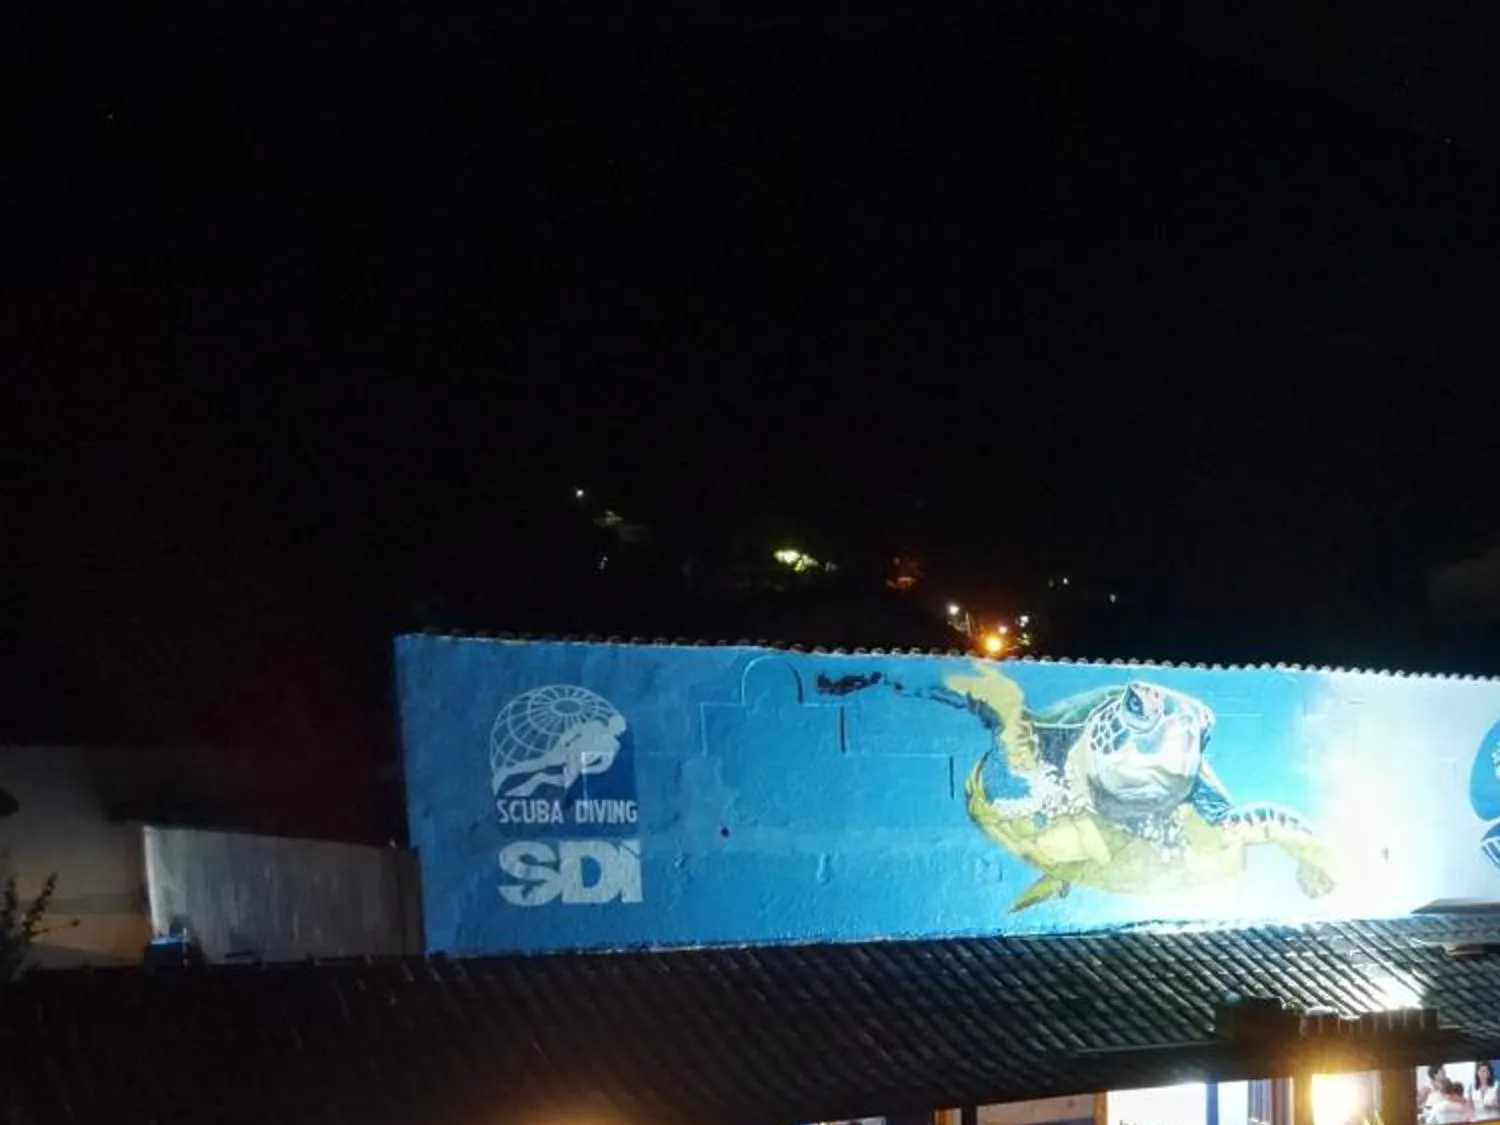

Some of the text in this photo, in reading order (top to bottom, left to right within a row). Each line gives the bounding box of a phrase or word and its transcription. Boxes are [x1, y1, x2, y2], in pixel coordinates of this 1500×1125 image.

[498, 800, 637, 825] SCUBA DIVING
[498, 839, 643, 907] SDI
